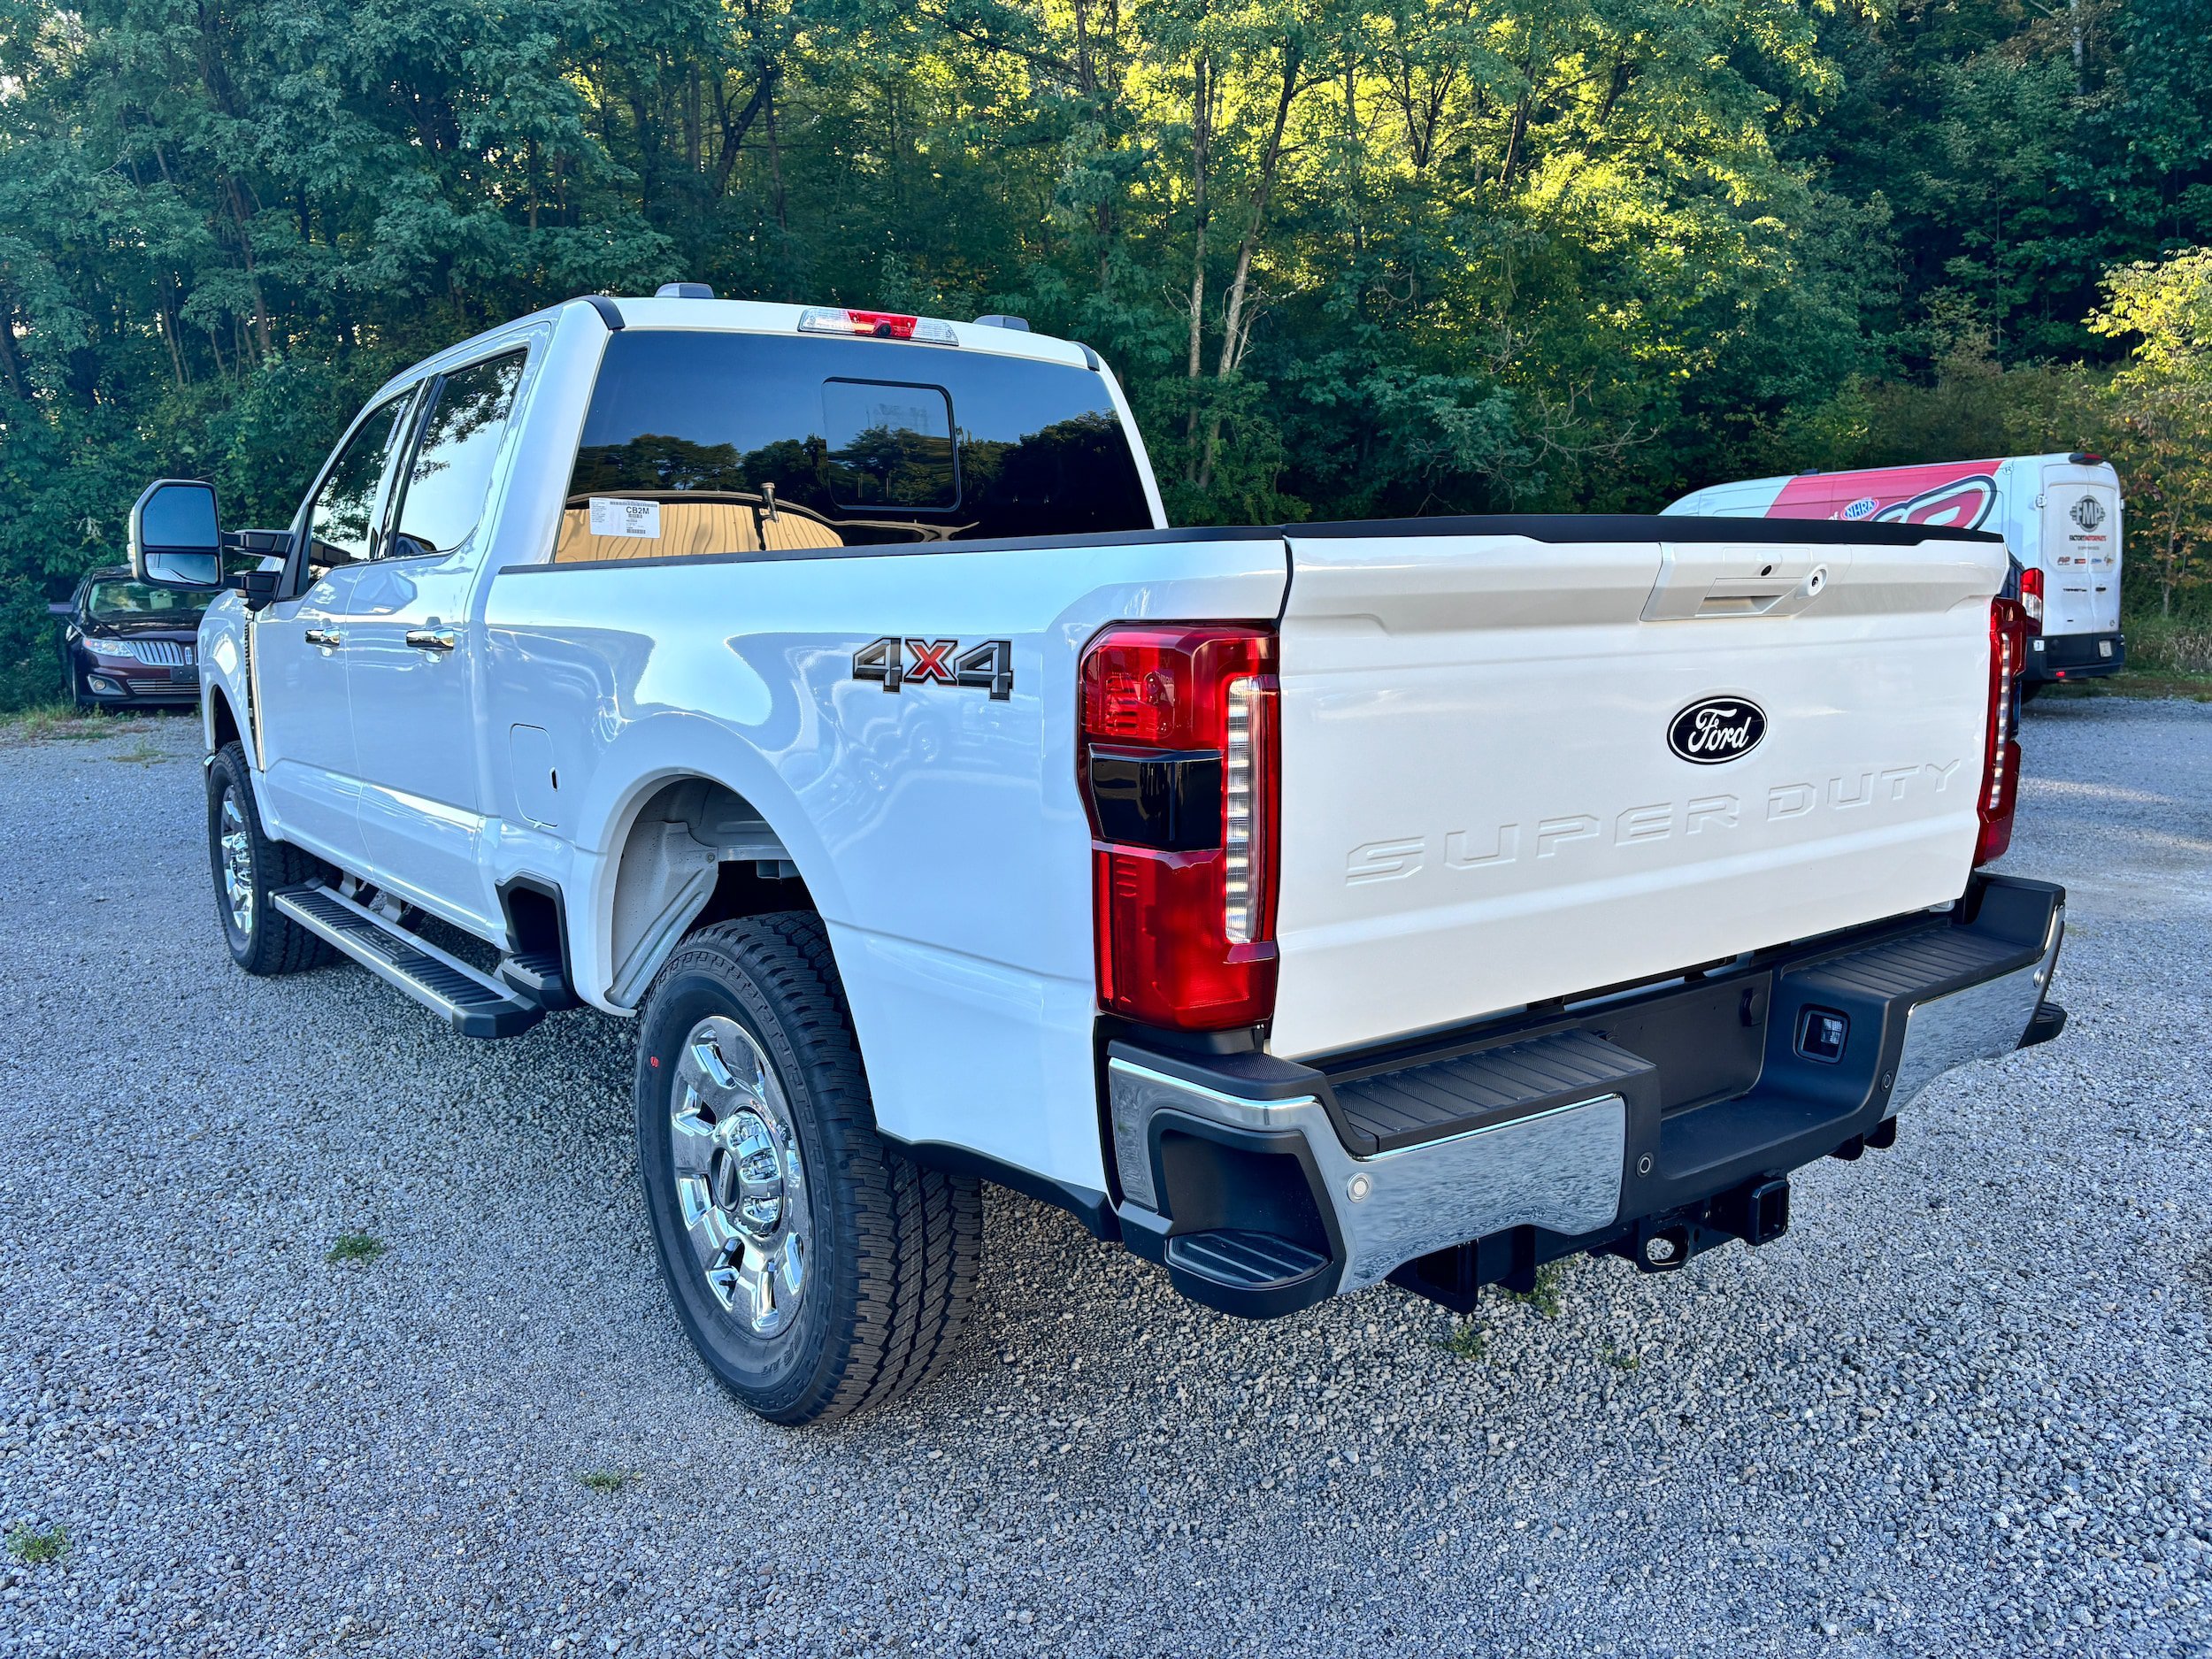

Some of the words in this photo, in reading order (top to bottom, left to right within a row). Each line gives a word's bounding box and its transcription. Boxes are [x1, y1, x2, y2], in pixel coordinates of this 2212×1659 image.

[626, 506, 649, 515] CB2M
[1846, 500, 1874, 518] NHRA
[2076, 502, 2101, 525] FMP
[1687, 708, 1752, 753] Ford
[1346, 794, 1740, 887] SUPER
[1766, 758, 1962, 823] DUTY
